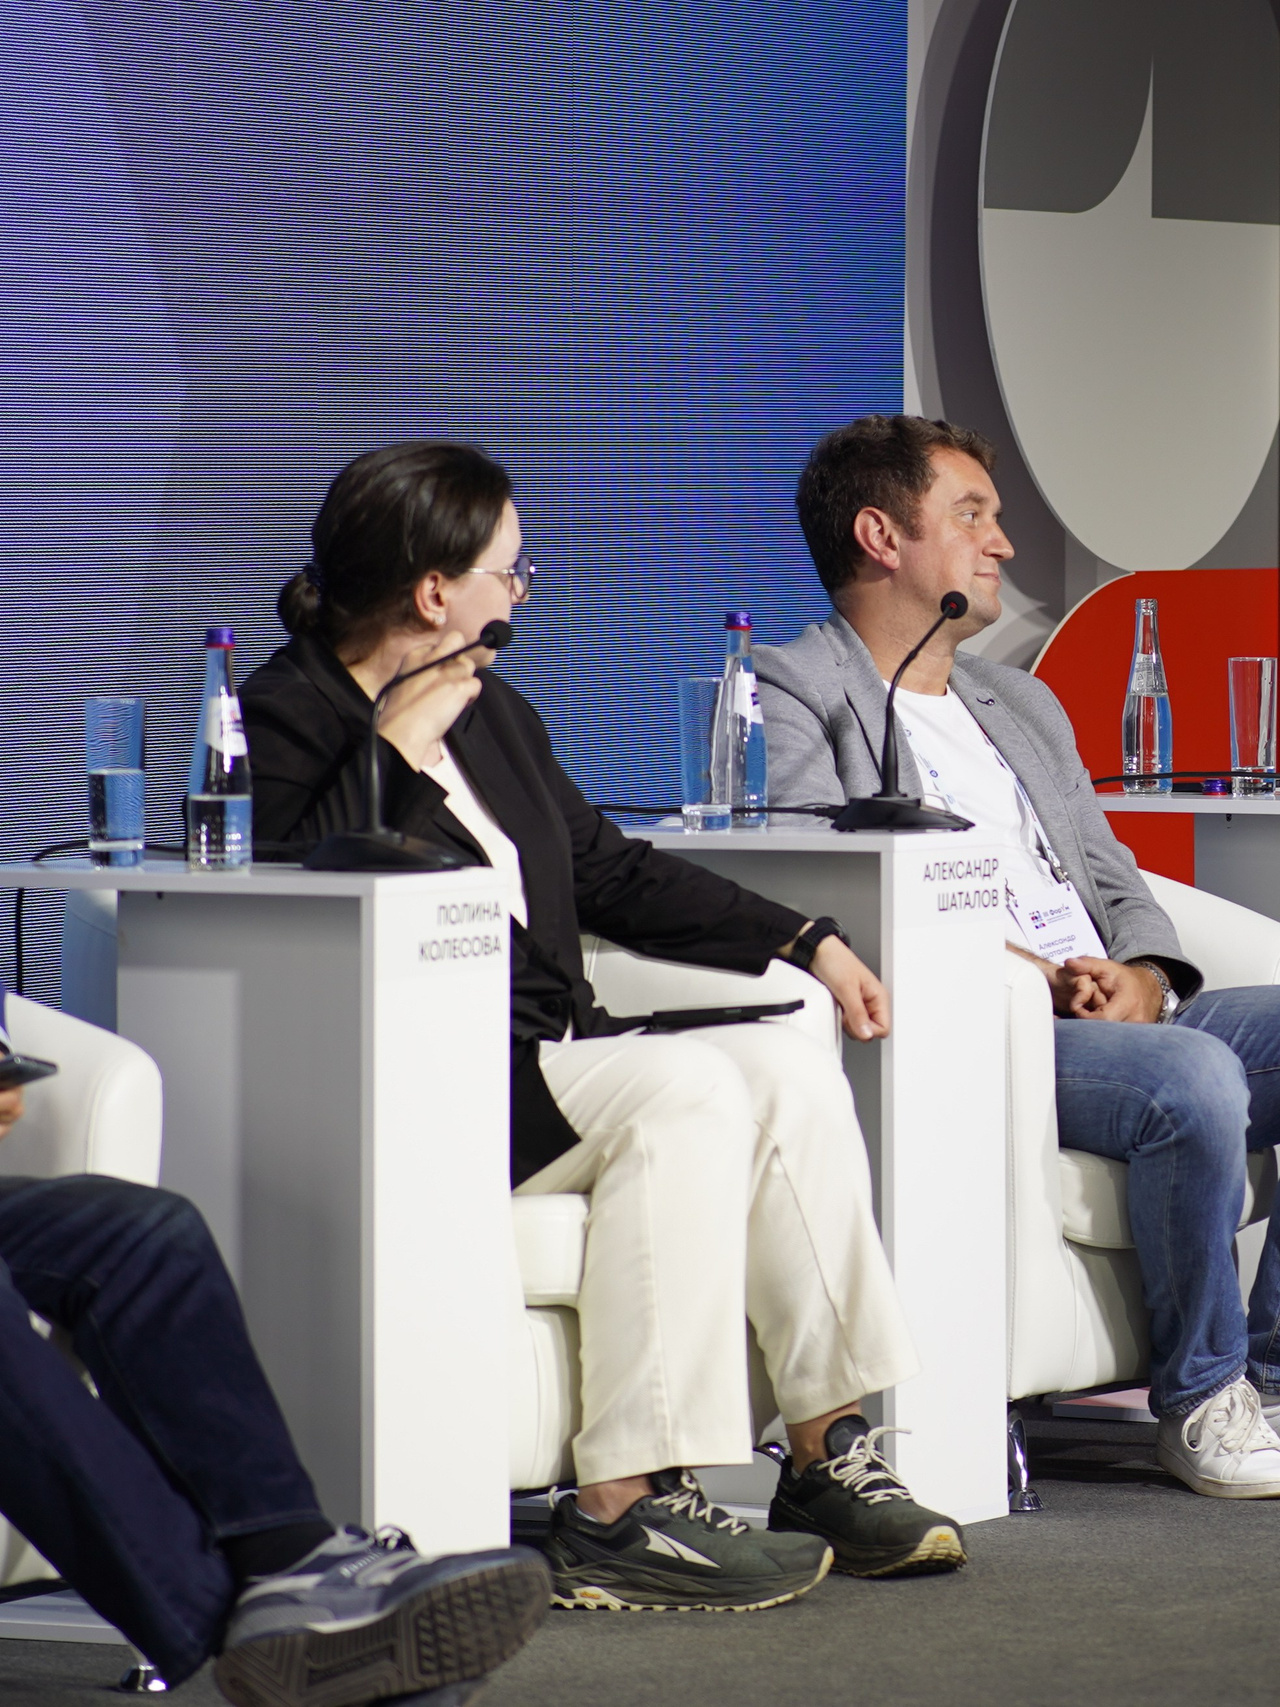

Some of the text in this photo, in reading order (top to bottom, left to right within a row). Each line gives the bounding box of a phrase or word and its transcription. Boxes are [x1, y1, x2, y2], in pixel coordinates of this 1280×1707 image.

[923, 858, 999, 882] АЛЕКСАНДР
[938, 889, 998, 912] ШАТАЛОВ
[437, 902, 502, 926] ПОЛИНА
[419, 935, 502, 962] КОЛЕСОВА
[1038, 934, 1076, 951] Александр
